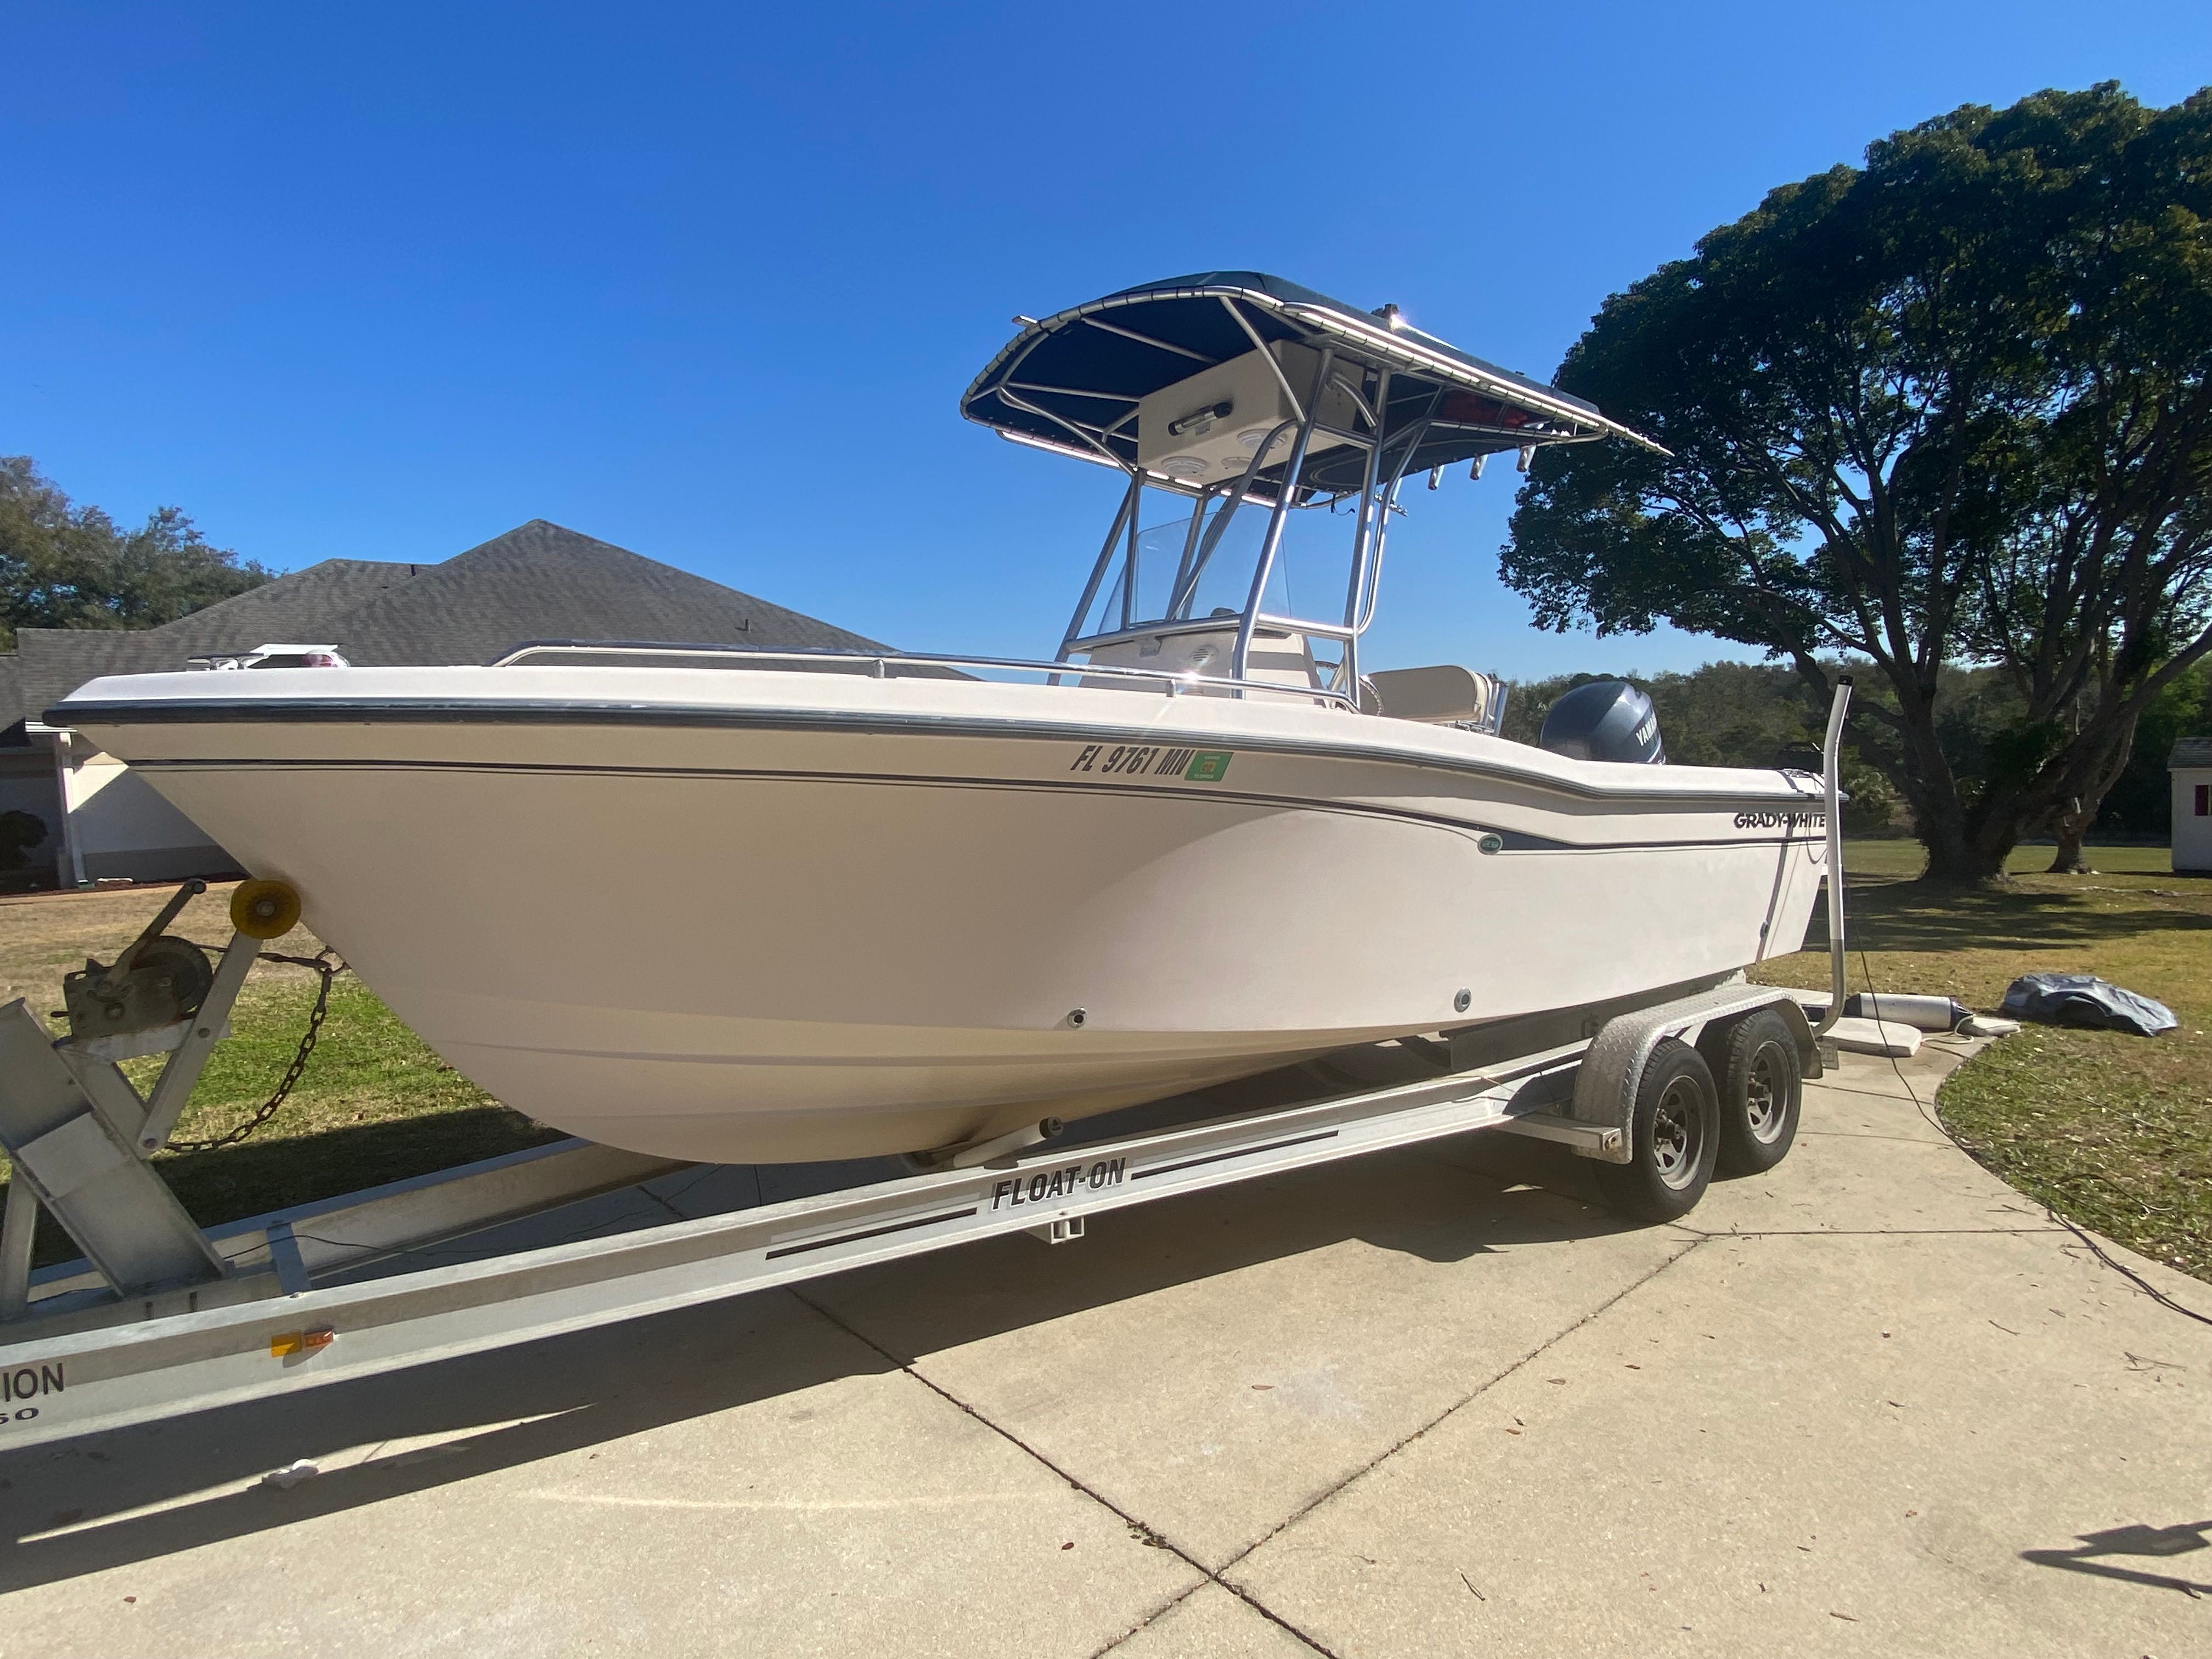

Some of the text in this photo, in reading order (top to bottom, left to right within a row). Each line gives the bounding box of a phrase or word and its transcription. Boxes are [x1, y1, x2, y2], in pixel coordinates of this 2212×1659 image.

[1070, 745, 1196, 775] FL 9761 MN
[1733, 812, 1826, 829] GRADY-WHITE
[992, 1157, 1126, 1210] FLOAT-ON
[3, 1362, 64, 1402] ION
